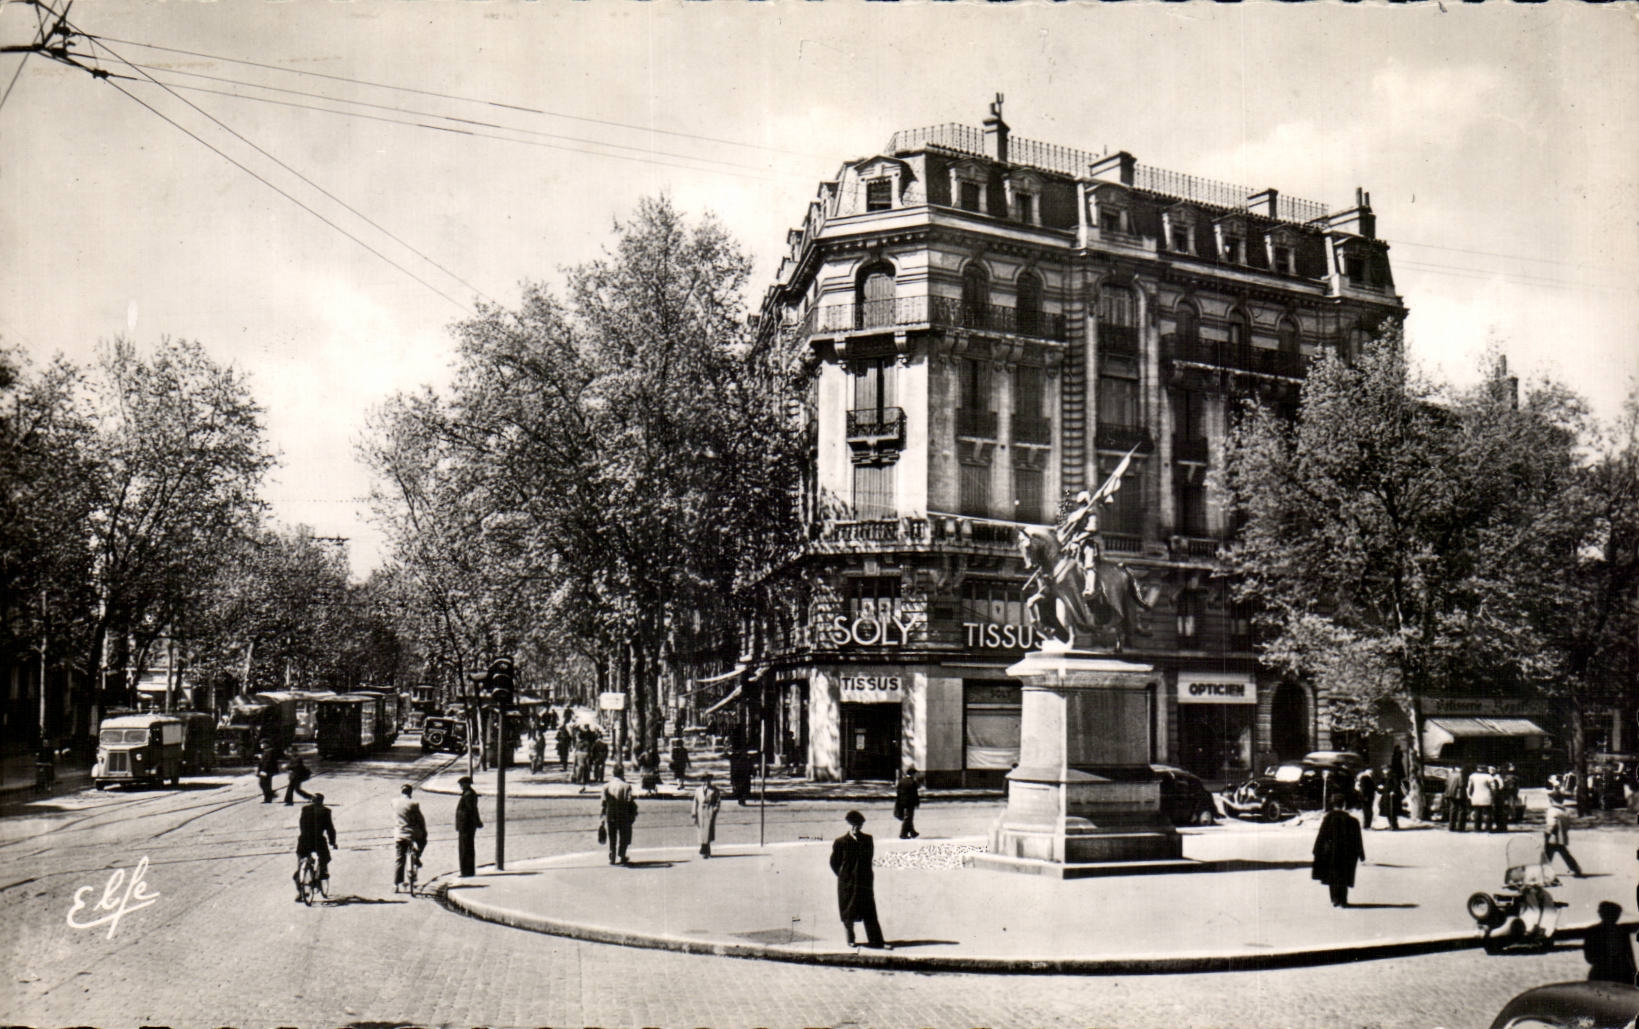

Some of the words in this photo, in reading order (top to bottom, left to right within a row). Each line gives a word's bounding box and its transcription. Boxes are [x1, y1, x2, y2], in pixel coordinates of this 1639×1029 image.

[829, 615, 918, 646] SOLY
[841, 677, 899, 691] TISSUS
[1188, 683, 1245, 697] OPTICIEN
